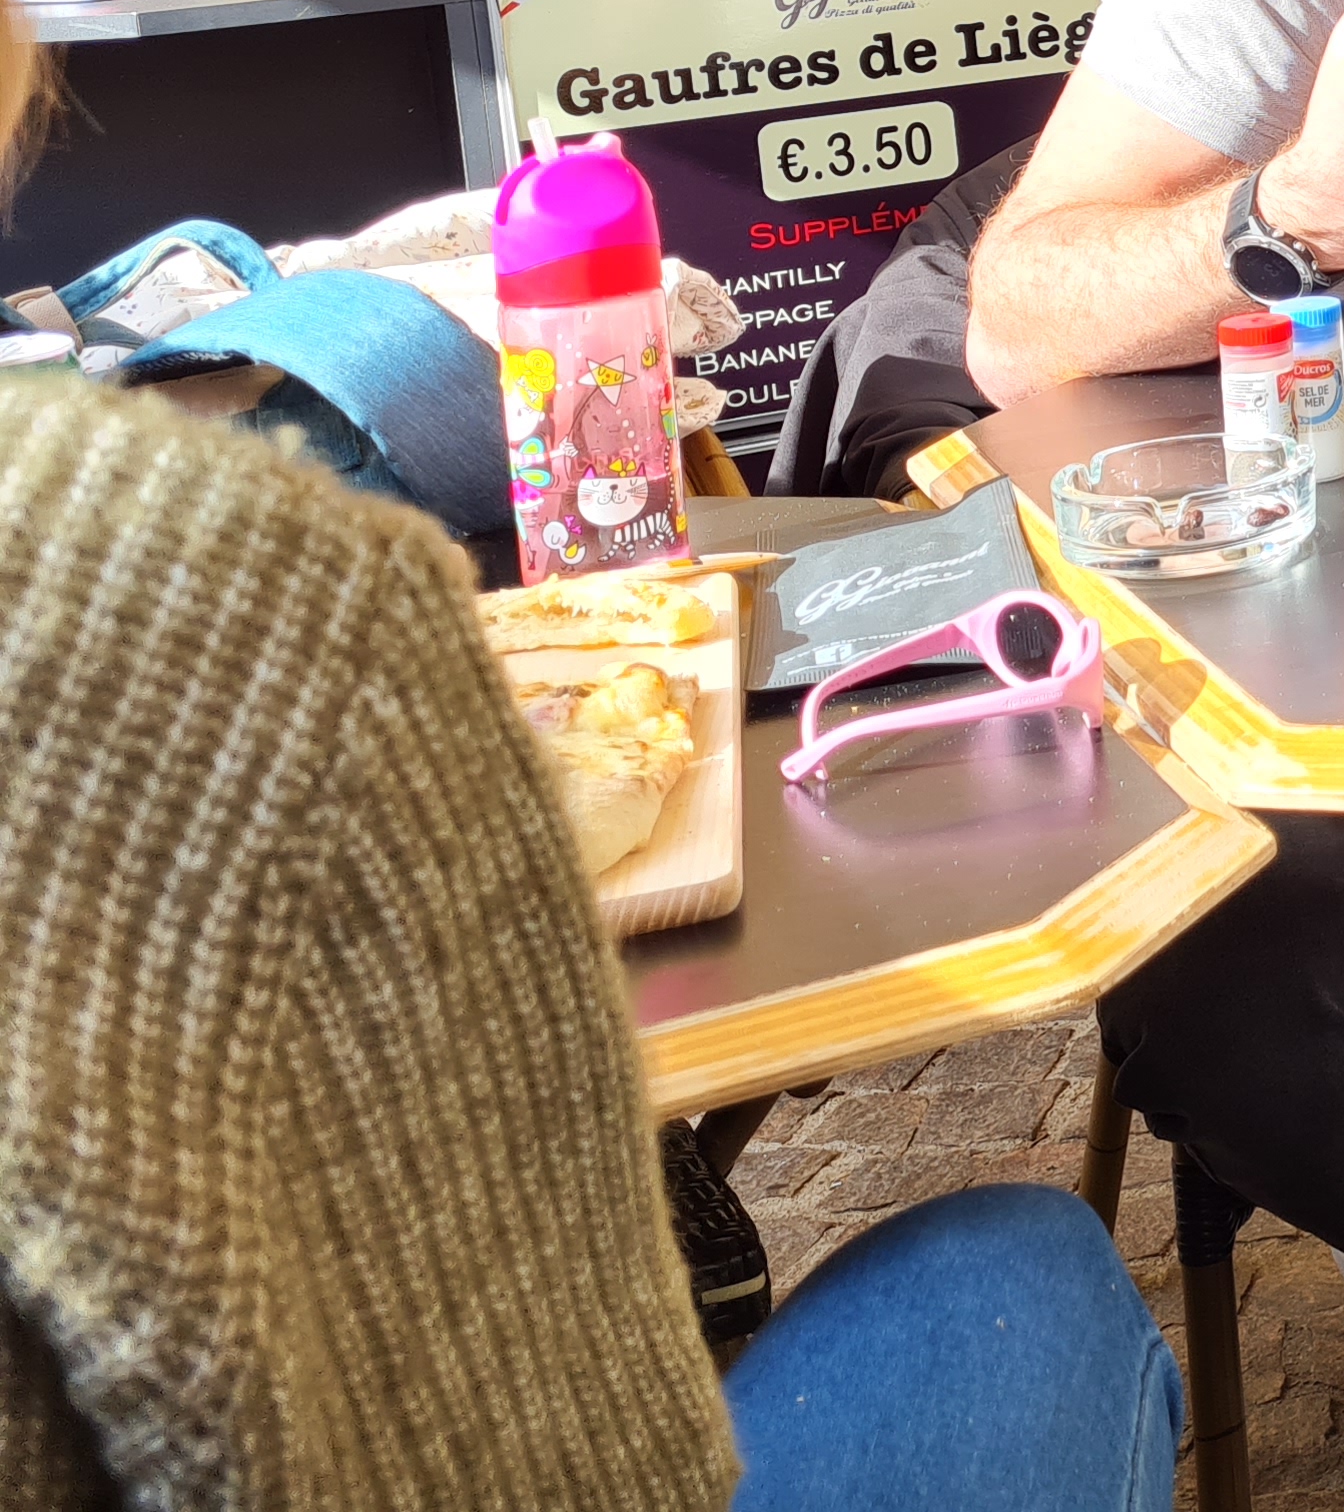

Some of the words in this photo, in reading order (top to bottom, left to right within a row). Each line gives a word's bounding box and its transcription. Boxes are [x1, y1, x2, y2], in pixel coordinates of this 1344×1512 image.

[555, 48, 841, 117] Gaufres
[859, 32, 938, 80] de
[954, 10, 1096, 68] Lièg
[776, 120, 934, 185] €.3.50
[724, 260, 846, 297] HANTILLY
[694, 339, 816, 377] BANANE
[1293, 363, 1331, 376] Ducros
[1298, 386, 1317, 398] SEL
[1317, 384, 1330, 395] DE
[1304, 396, 1326, 409] MER
